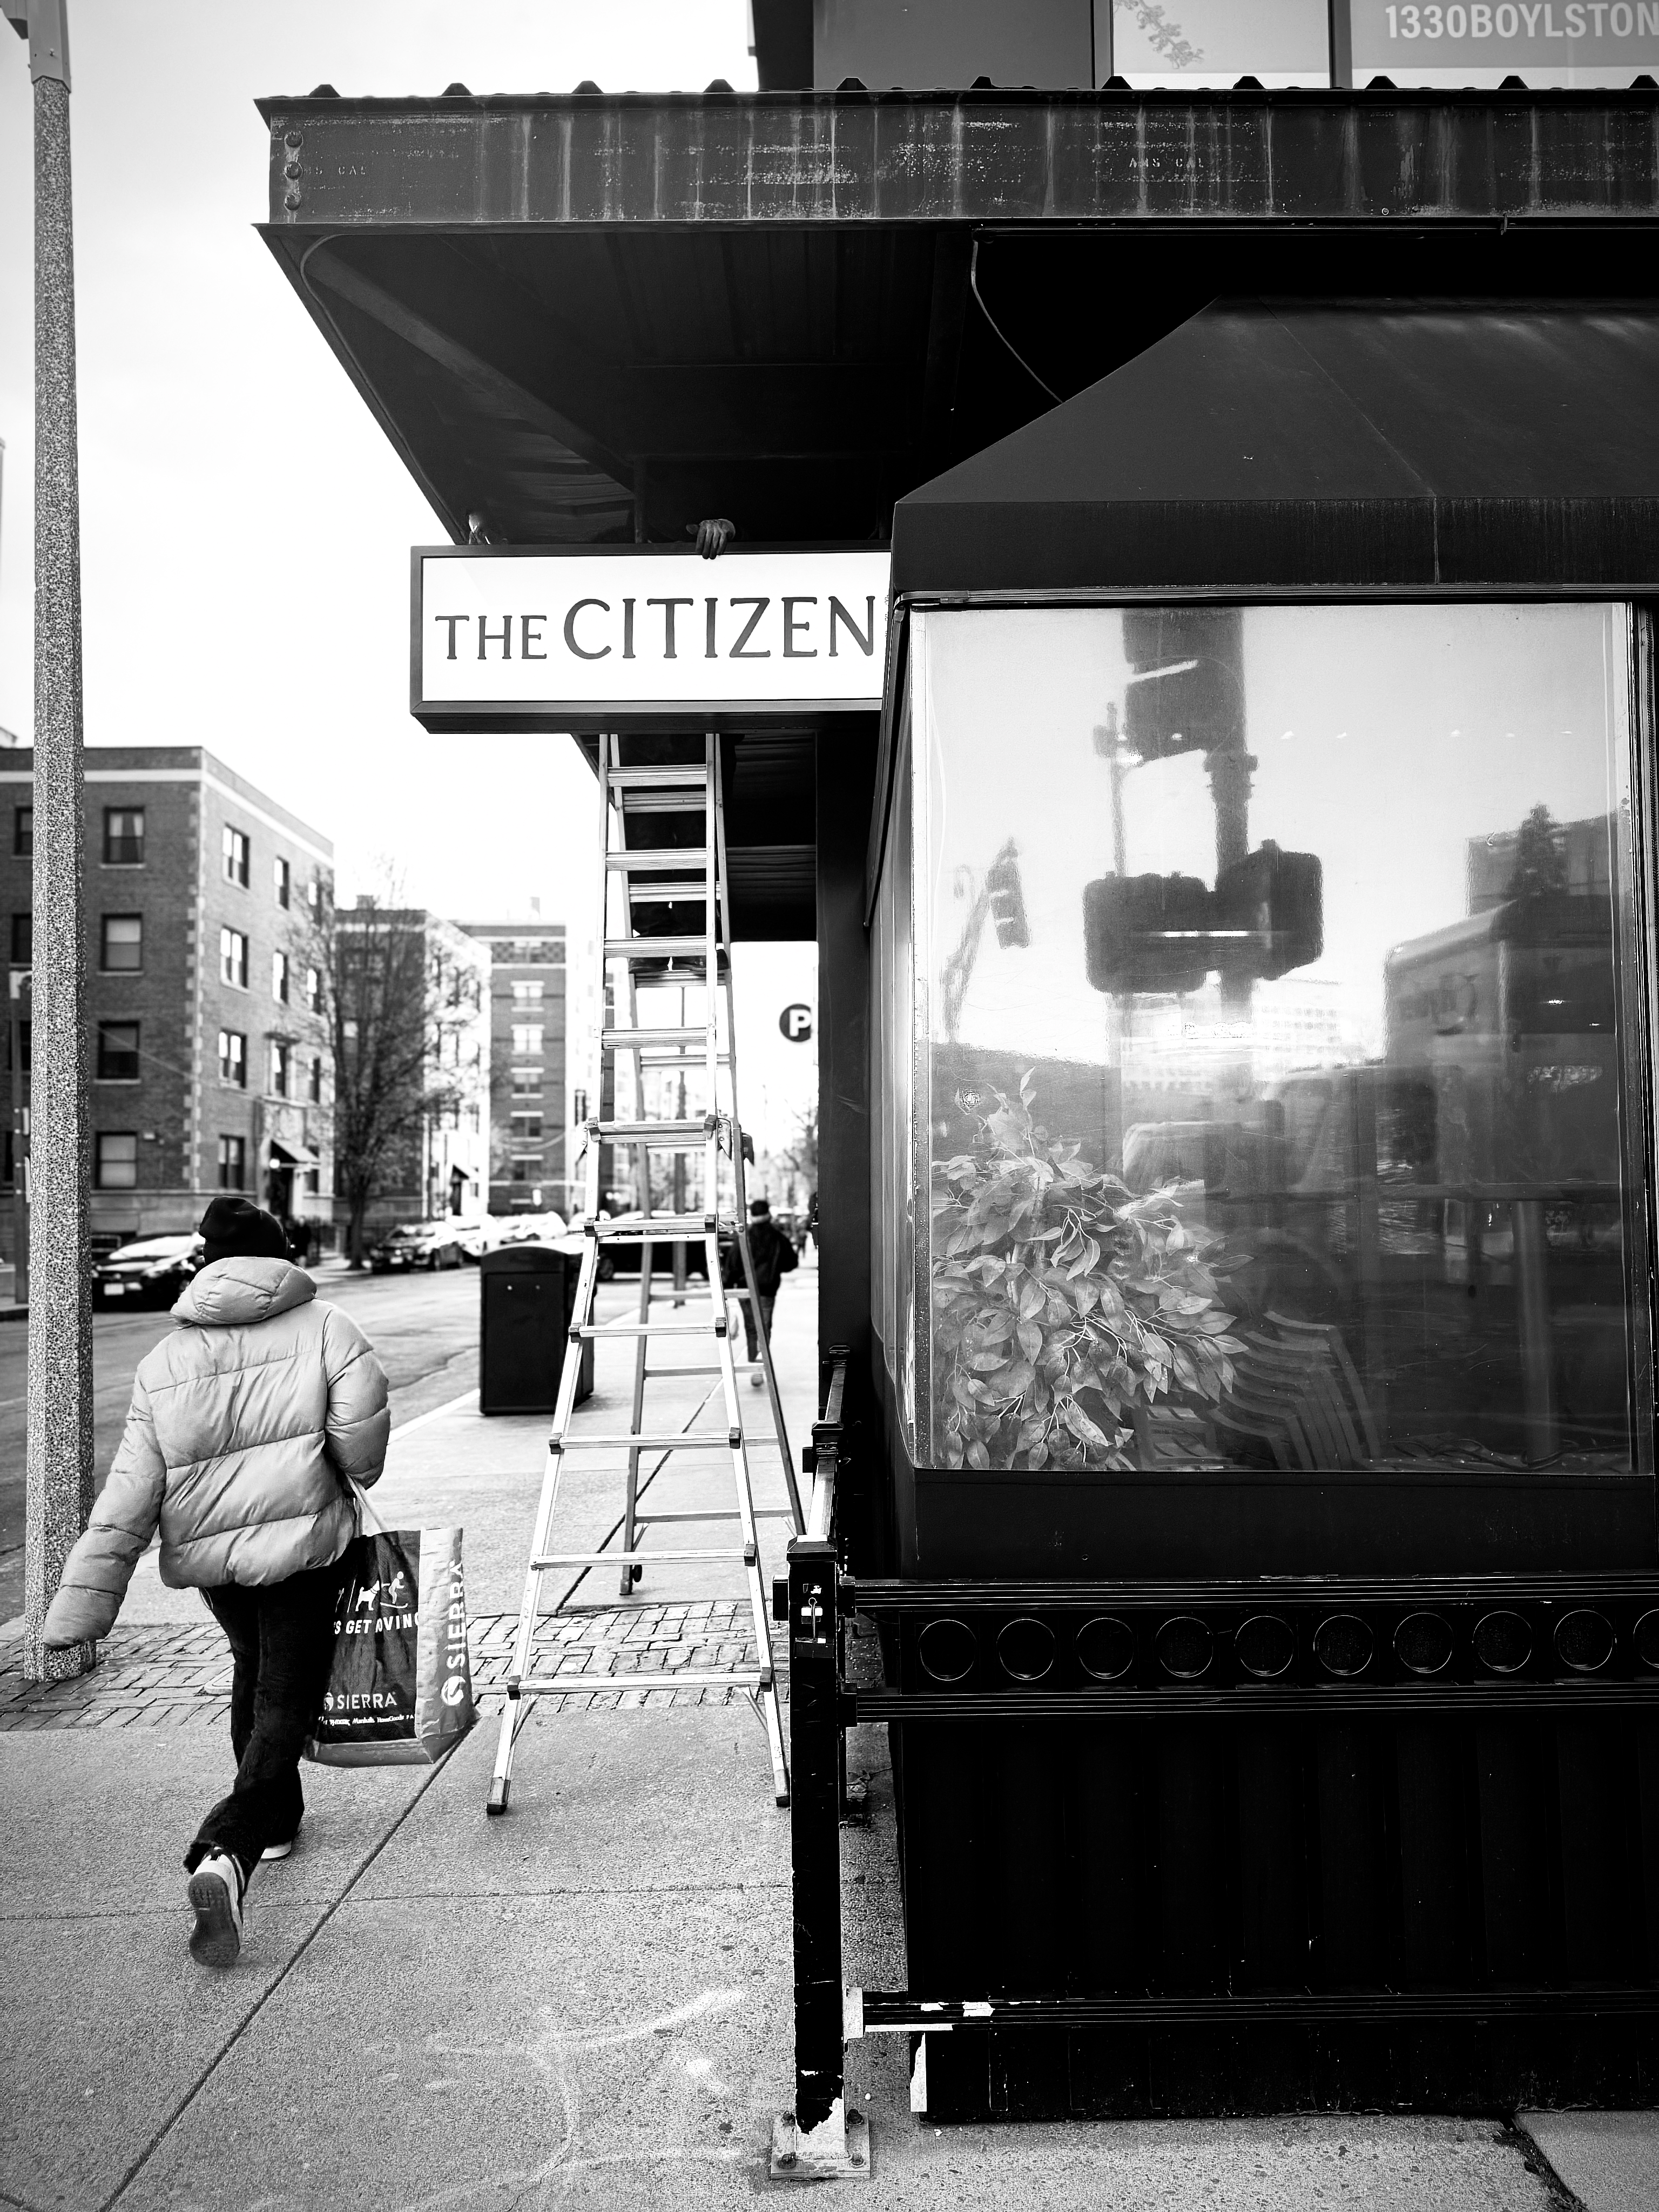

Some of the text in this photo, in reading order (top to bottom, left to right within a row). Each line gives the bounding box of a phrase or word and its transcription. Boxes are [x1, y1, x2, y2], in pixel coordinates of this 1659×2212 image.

[435, 615, 547, 660] THE
[563, 596, 875, 660] CITIZEN
[789, 1009, 811, 1037] P
[346, 1619, 372, 1634] GET
[446, 1562, 466, 1670] SIERRA
[337, 1692, 397, 1710] SIERRA
[376, 1714, 404, 1723] HomeGoods
